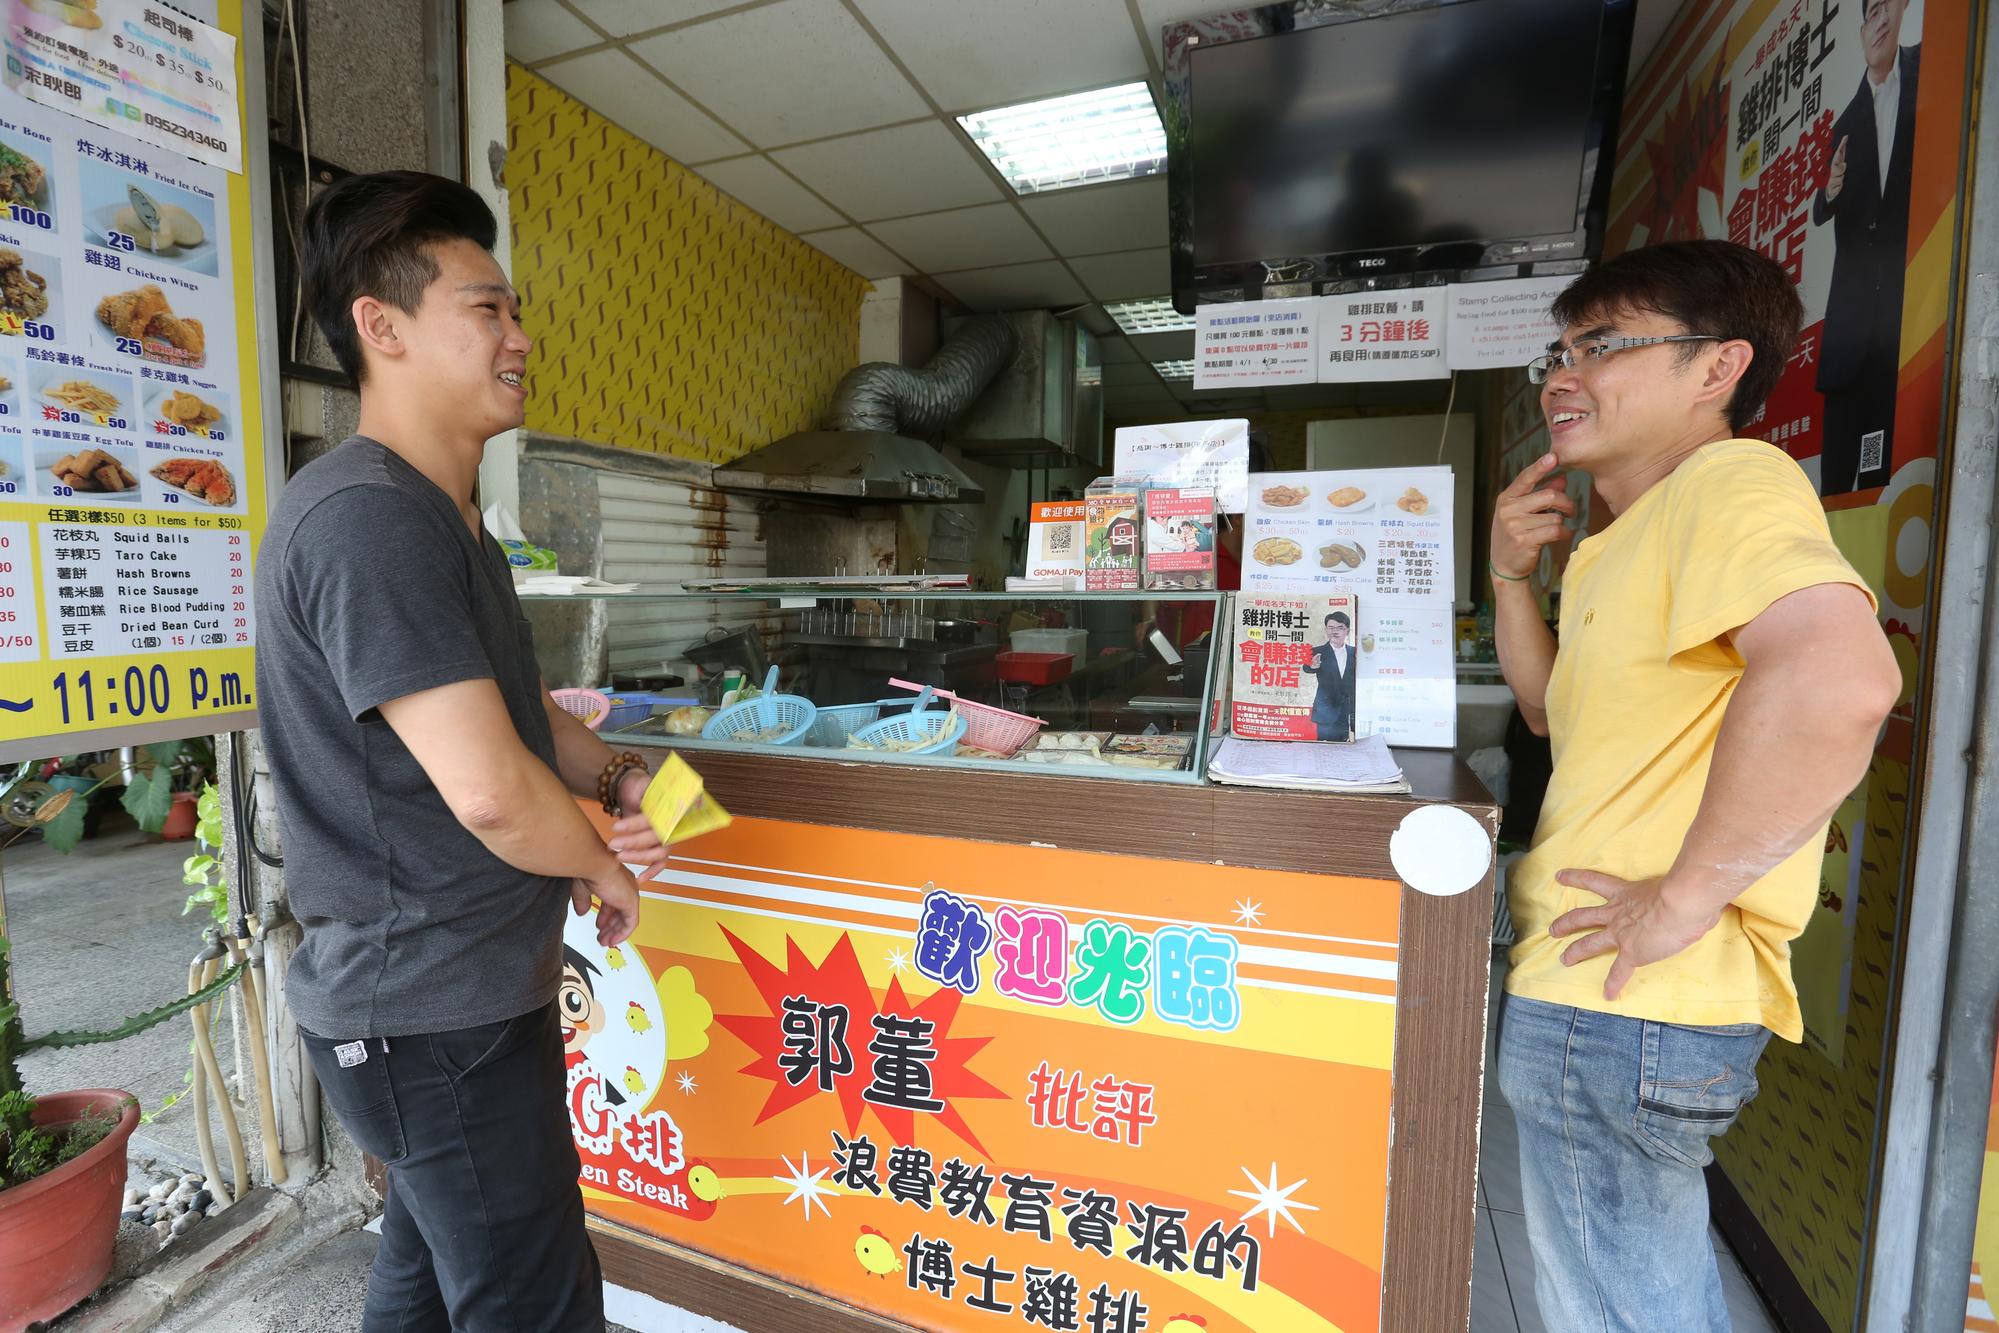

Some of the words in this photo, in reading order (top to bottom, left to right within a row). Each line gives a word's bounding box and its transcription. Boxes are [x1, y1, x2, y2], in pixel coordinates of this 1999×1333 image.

[143, 8, 194, 42] 起司棒
[180, 47, 213, 70] Stick
[1737, 0, 1839, 152] 雞排博士
[1762, 73, 1822, 165] 開一間
[23, 127, 52, 143] Bone
[144, 113, 227, 152] 0952343460
[77, 138, 149, 175] 炸冰淇淋
[154, 172, 176, 186] Fried
[179, 180, 190, 190] Ice
[193, 185, 214, 199] Cream
[1727, 108, 1833, 248] 會賺錢
[9, 204, 51, 230] 100
[108, 231, 135, 251] 25
[84, 249, 121, 272] 雞翅
[1359, 259, 1386, 268] TECO
[127, 266, 167, 283] Chicken
[170, 276, 199, 291] Wings
[1459, 297, 1488, 306] Stamp
[1491, 293, 1538, 304] Collecting
[24, 321, 55, 341] 50
[115, 337, 142, 355] 25
[26, 347, 85, 367] 馬鈴薯條
[140, 367, 190, 385] 麥克雞塊
[61, 411, 80, 423] 30
[108, 418, 126, 429] 50
[95, 437, 112, 446] Egg
[114, 439, 134, 447] Tofu
[170, 426, 186, 436] 30
[209, 431, 225, 441] 50
[173, 445, 204, 455] Chicken
[53, 485, 73, 498] 30
[162, 493, 179, 504] 70
[1041, 506, 1085, 518] 歡迎使用
[156, 515, 187, 526] Items
[194, 518, 211, 527] for
[218, 518, 242, 529] $50)
[114, 532, 149, 544] Squid
[157, 533, 190, 544] Balls
[228, 535, 241, 545] 20
[115, 551, 144, 561] Taro
[150, 551, 177, 561] Cake
[229, 552, 242, 562] 20
[117, 569, 145, 579] Hash
[151, 569, 191, 579] Browns
[231, 569, 243, 578] 20
[1069, 569, 1084, 577] Pay
[118, 586, 147, 596] Rice
[153, 586, 199, 597] Sausage
[232, 586, 244, 595] 20
[119, 604, 145, 614] Rice
[151, 603, 181, 613] Blood
[186, 602, 225, 613] Pudding
[233, 602, 245, 611] 20
[121, 622, 156, 633] Dried
[162, 621, 189, 631] Bean
[193, 620, 219, 629] Curd
[234, 618, 246, 628] 20
[1242, 608, 1310, 629] 雞排博士
[64, 640, 94, 653] 豆皮
[171, 636, 185, 646] 15
[236, 633, 248, 642] 25
[1265, 630, 1304, 643] 開一間
[1239, 639, 1313, 666] 會賺錢
[1250, 664, 1300, 688] 的店
[53, 664, 170, 724] 11:00
[189, 667, 252, 710] p.m.
[914, 890, 1241, 1031] 歡迎光臨
[778, 995, 945, 1112] 郭董
[1027, 1061, 1158, 1146] 批評
[617, 1168, 690, 1211] Steak
[831, 1129, 1261, 1291] 浪費教育資源的
[902, 1232, 1150, 1333] 博士雞排
